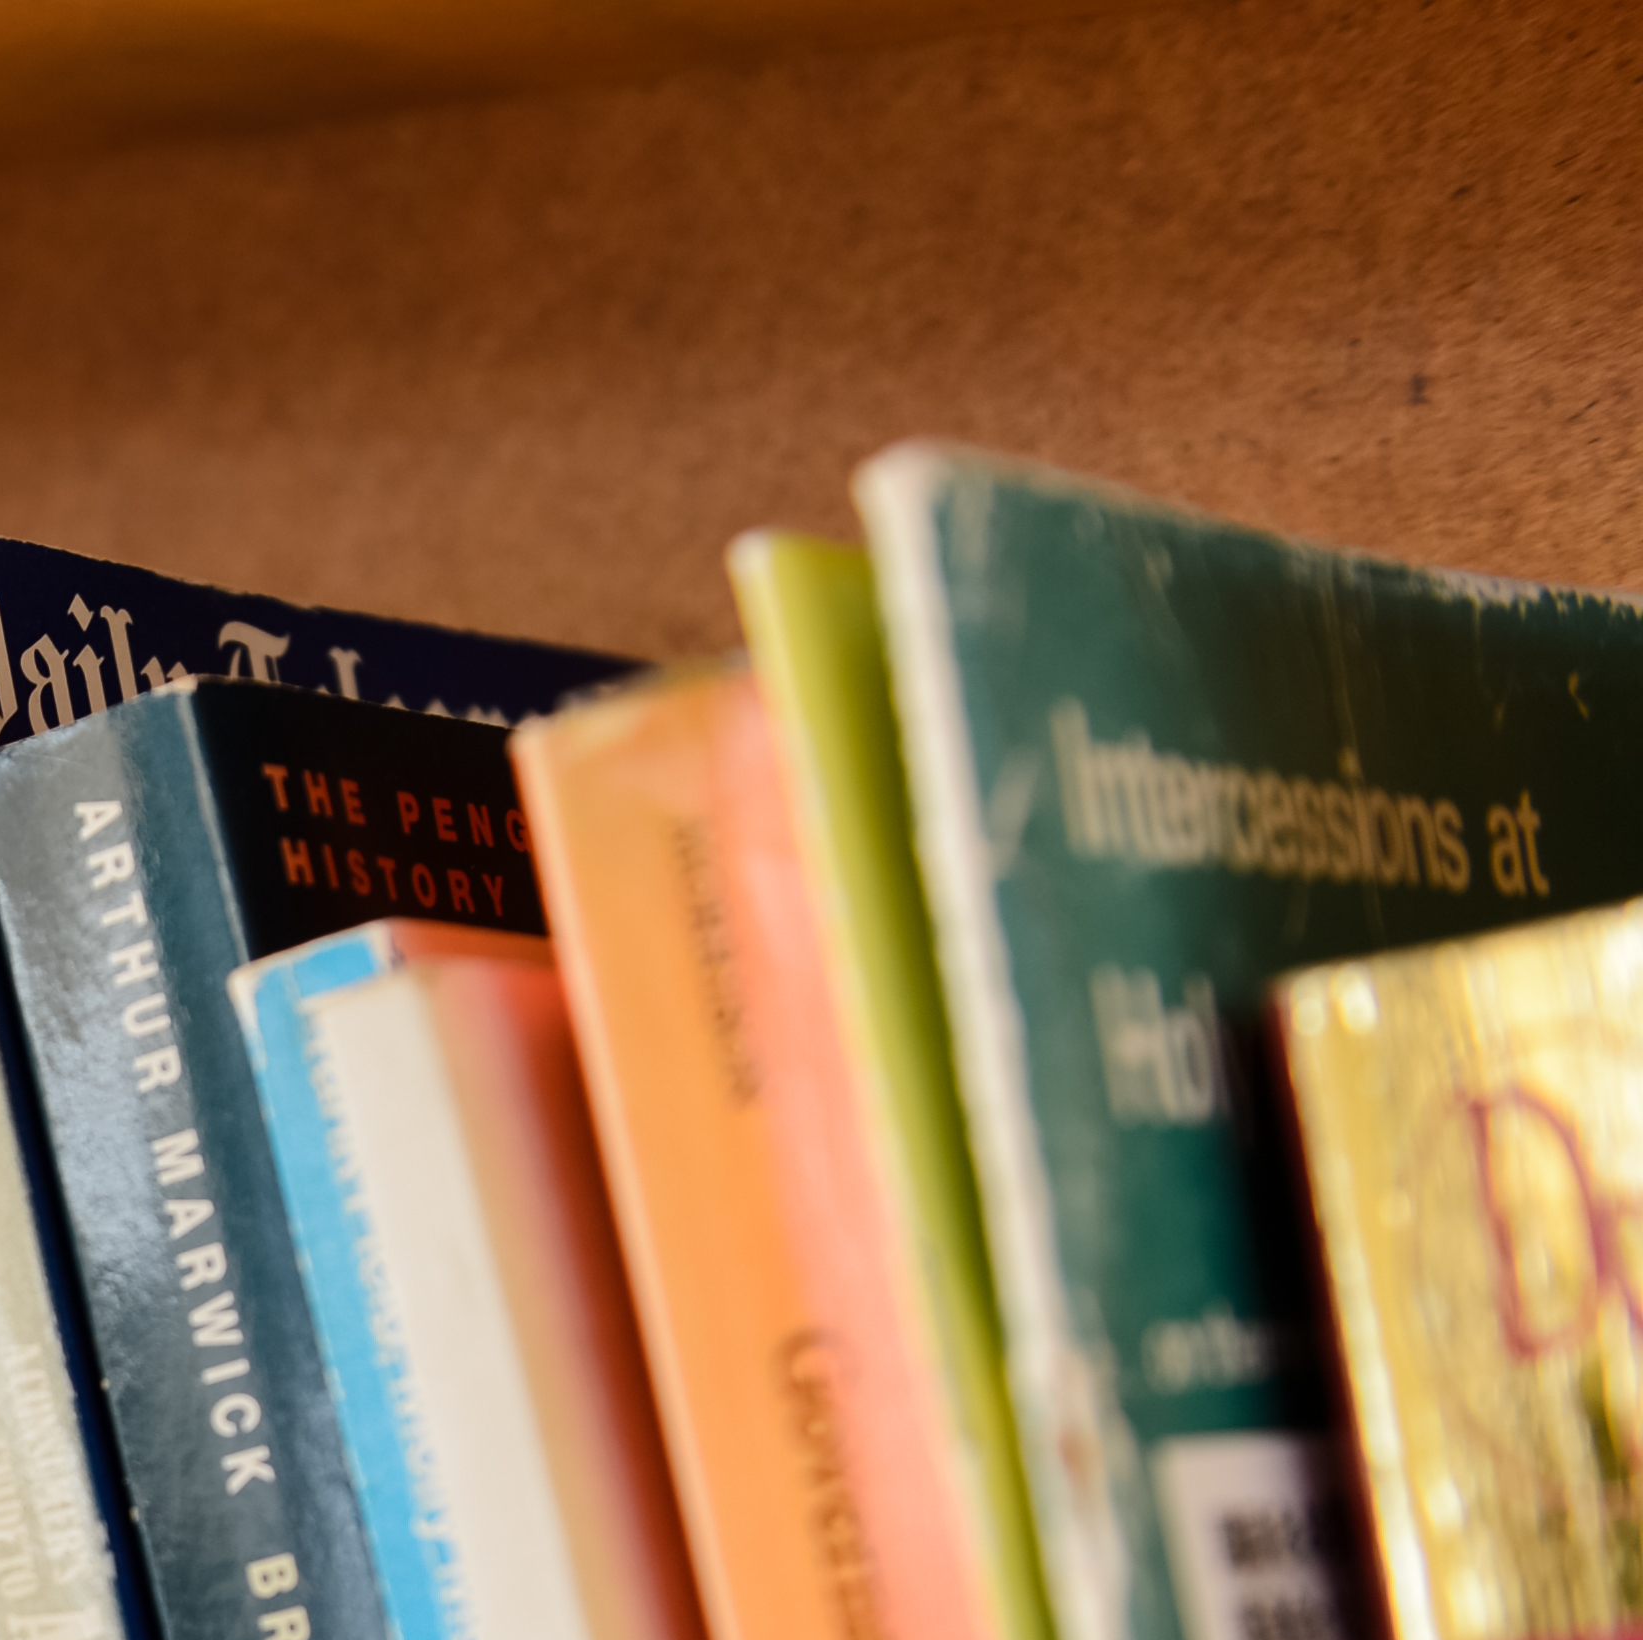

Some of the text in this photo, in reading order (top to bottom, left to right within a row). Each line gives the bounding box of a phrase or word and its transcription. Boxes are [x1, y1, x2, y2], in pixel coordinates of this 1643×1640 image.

[262, 763, 366, 825] THE
[1051, 696, 1550, 898] Intercessions at
[280, 836, 503, 917] HISTORY
[74, 797, 184, 1095] ARTHUR
[150, 1128, 276, 1495] MARWICK
